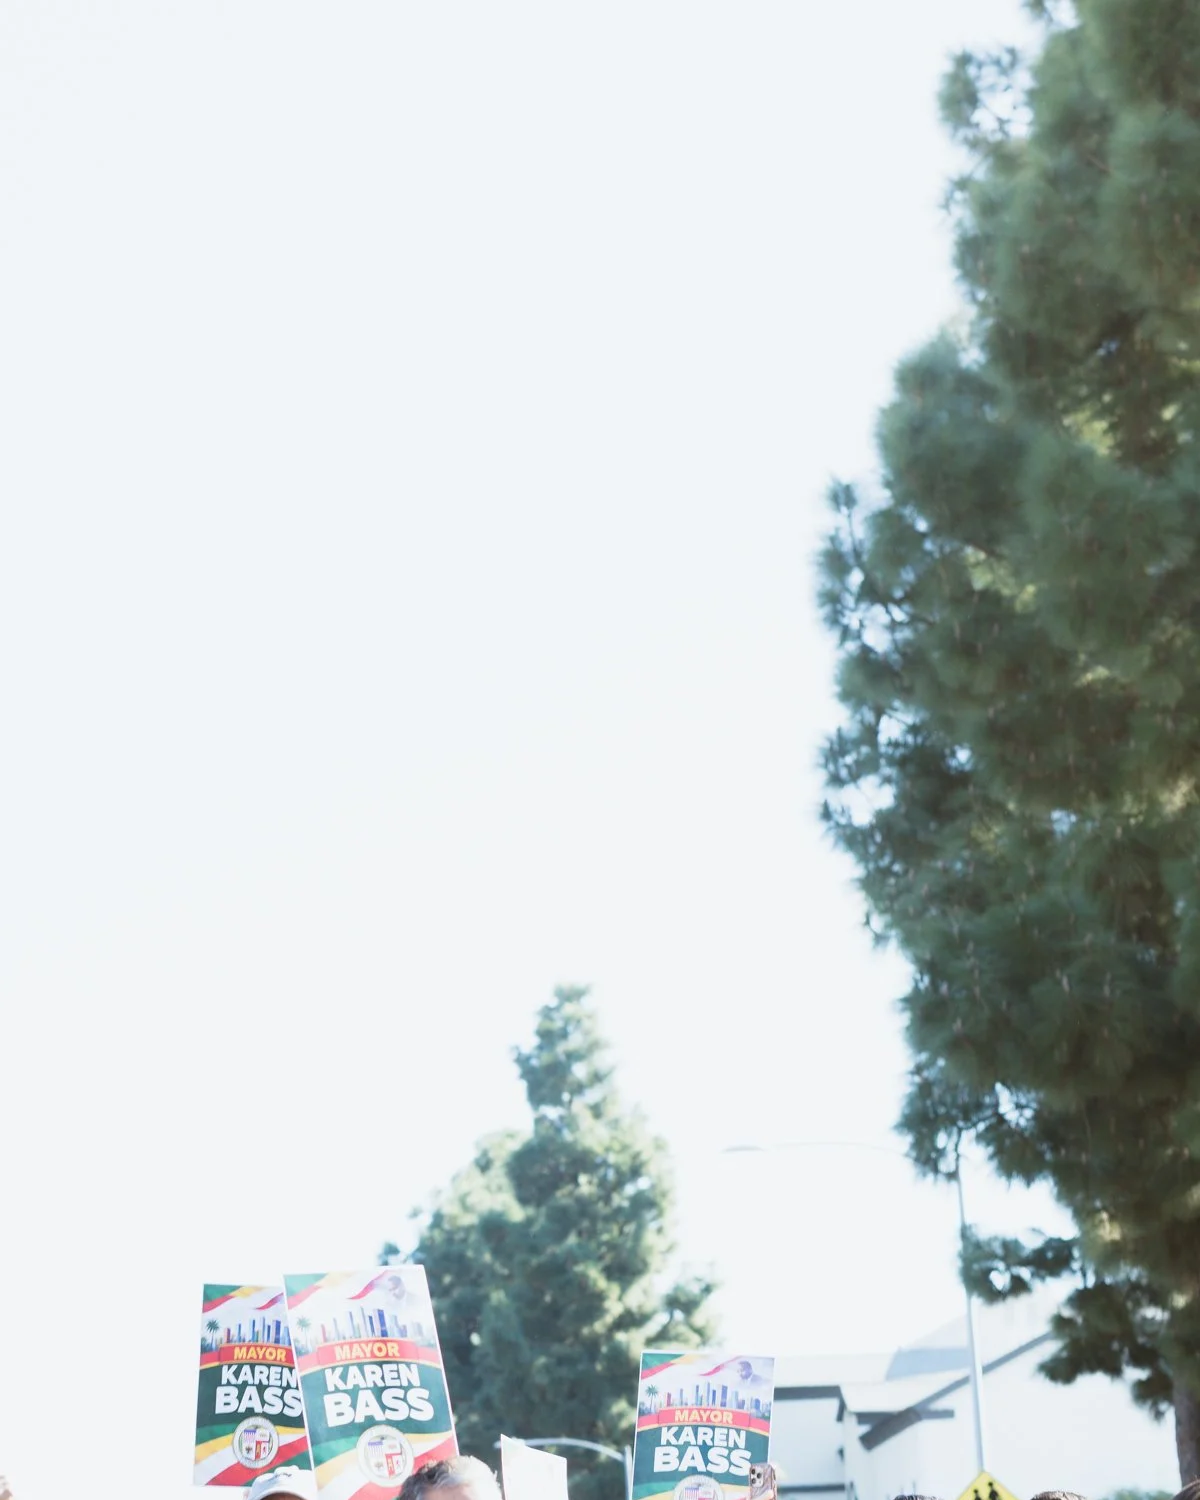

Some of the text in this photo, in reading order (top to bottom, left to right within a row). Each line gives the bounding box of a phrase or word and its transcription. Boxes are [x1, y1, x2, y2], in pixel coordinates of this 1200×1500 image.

[233, 1346, 286, 1362] MAYOR
[334, 1341, 400, 1361] MAYOR
[221, 1363, 298, 1388] KAREN
[324, 1362, 421, 1392] KAREN
[215, 1386, 304, 1417] BASS
[323, 1387, 435, 1428] BASS
[674, 1409, 733, 1424] MAYOR
[660, 1426, 746, 1449] KAREN
[653, 1445, 752, 1477] BASS
